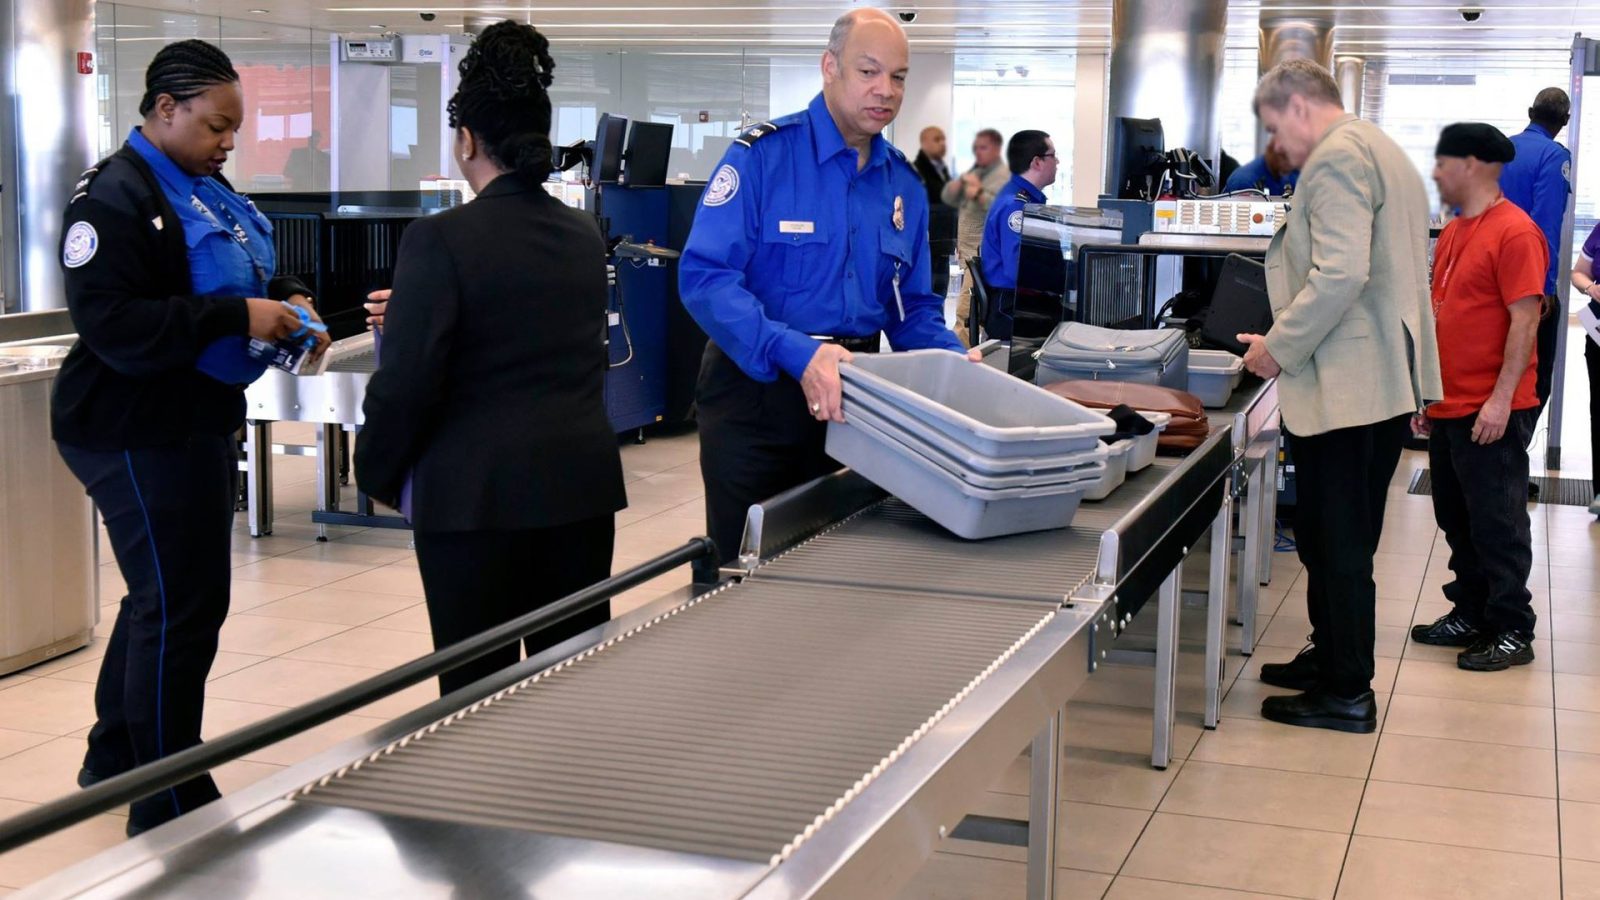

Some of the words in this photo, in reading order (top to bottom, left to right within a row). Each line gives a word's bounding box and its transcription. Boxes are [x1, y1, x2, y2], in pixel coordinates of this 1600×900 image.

[233, 223, 248, 243] TSA
[285, 354, 293, 366] L
[1446, 621, 1466, 635] N
[1498, 640, 1516, 654] N
